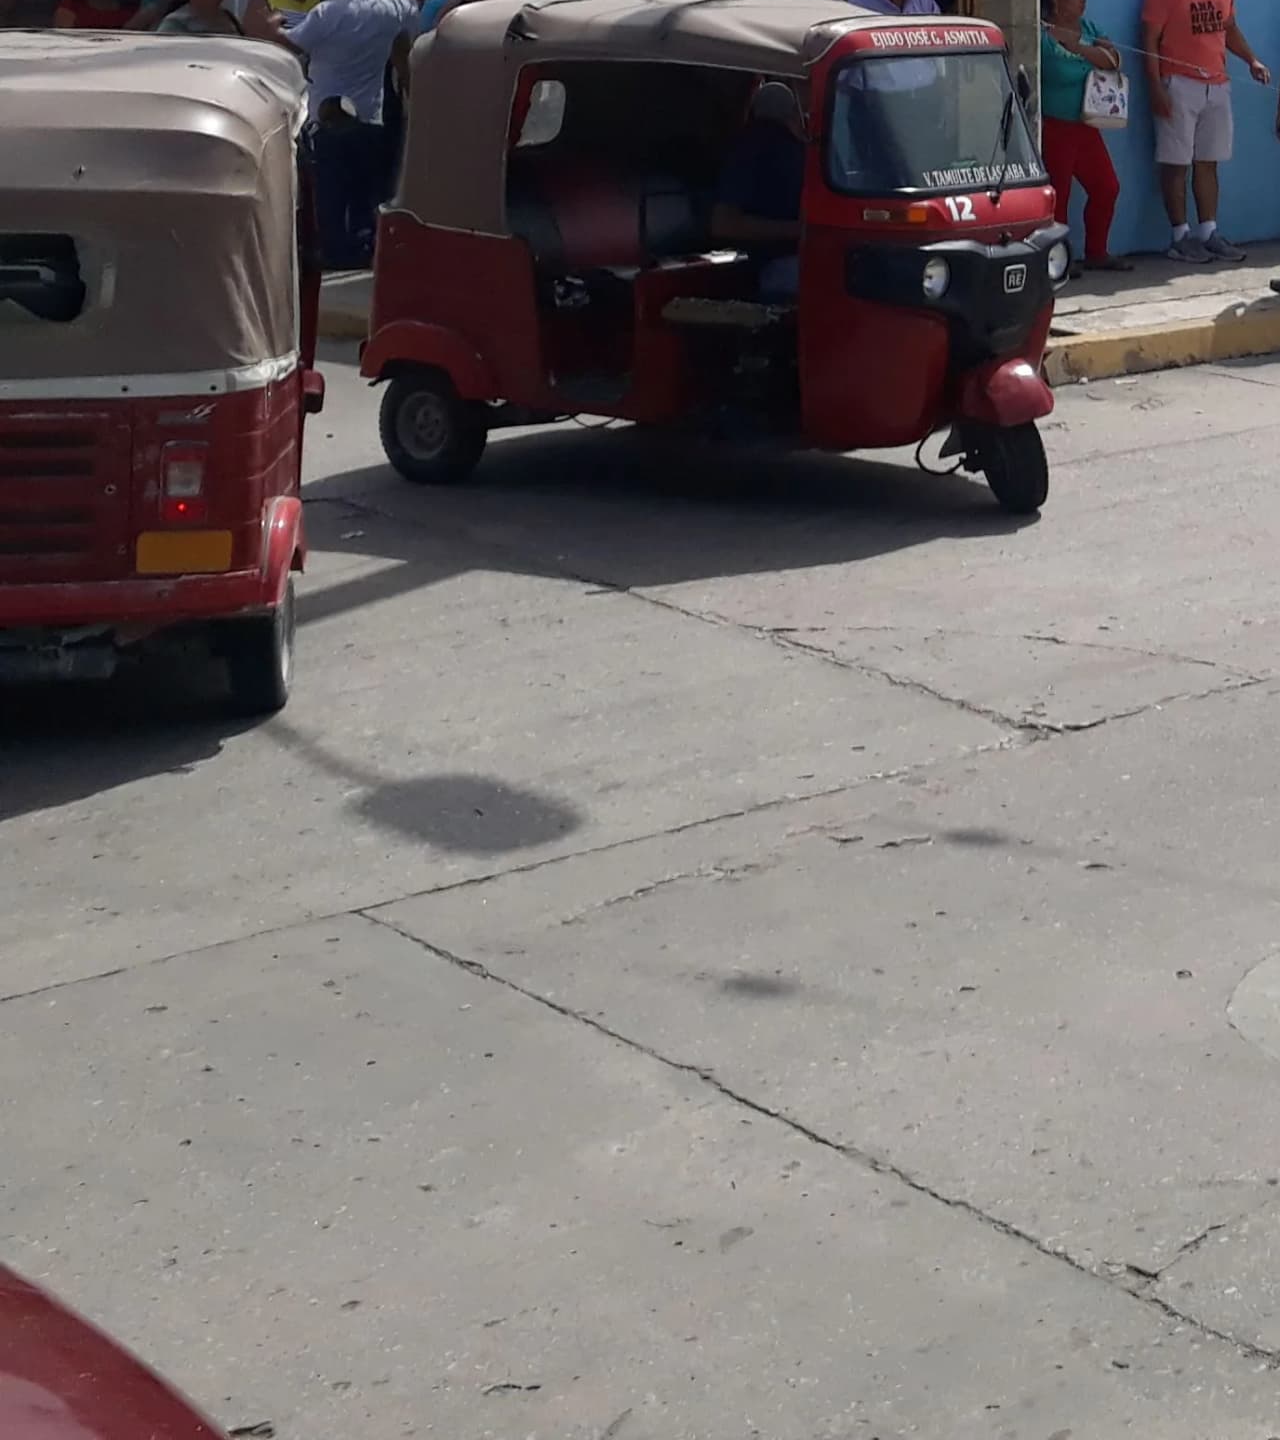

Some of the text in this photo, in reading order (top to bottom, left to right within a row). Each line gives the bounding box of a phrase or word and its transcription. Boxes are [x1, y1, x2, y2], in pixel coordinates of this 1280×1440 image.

[870, 31, 904, 48] EJIDO
[943, 30, 990, 45] ASMITIA
[973, 166, 986, 184] DE
[945, 195, 977, 222] 12
[1008, 272, 1023, 288] RE
